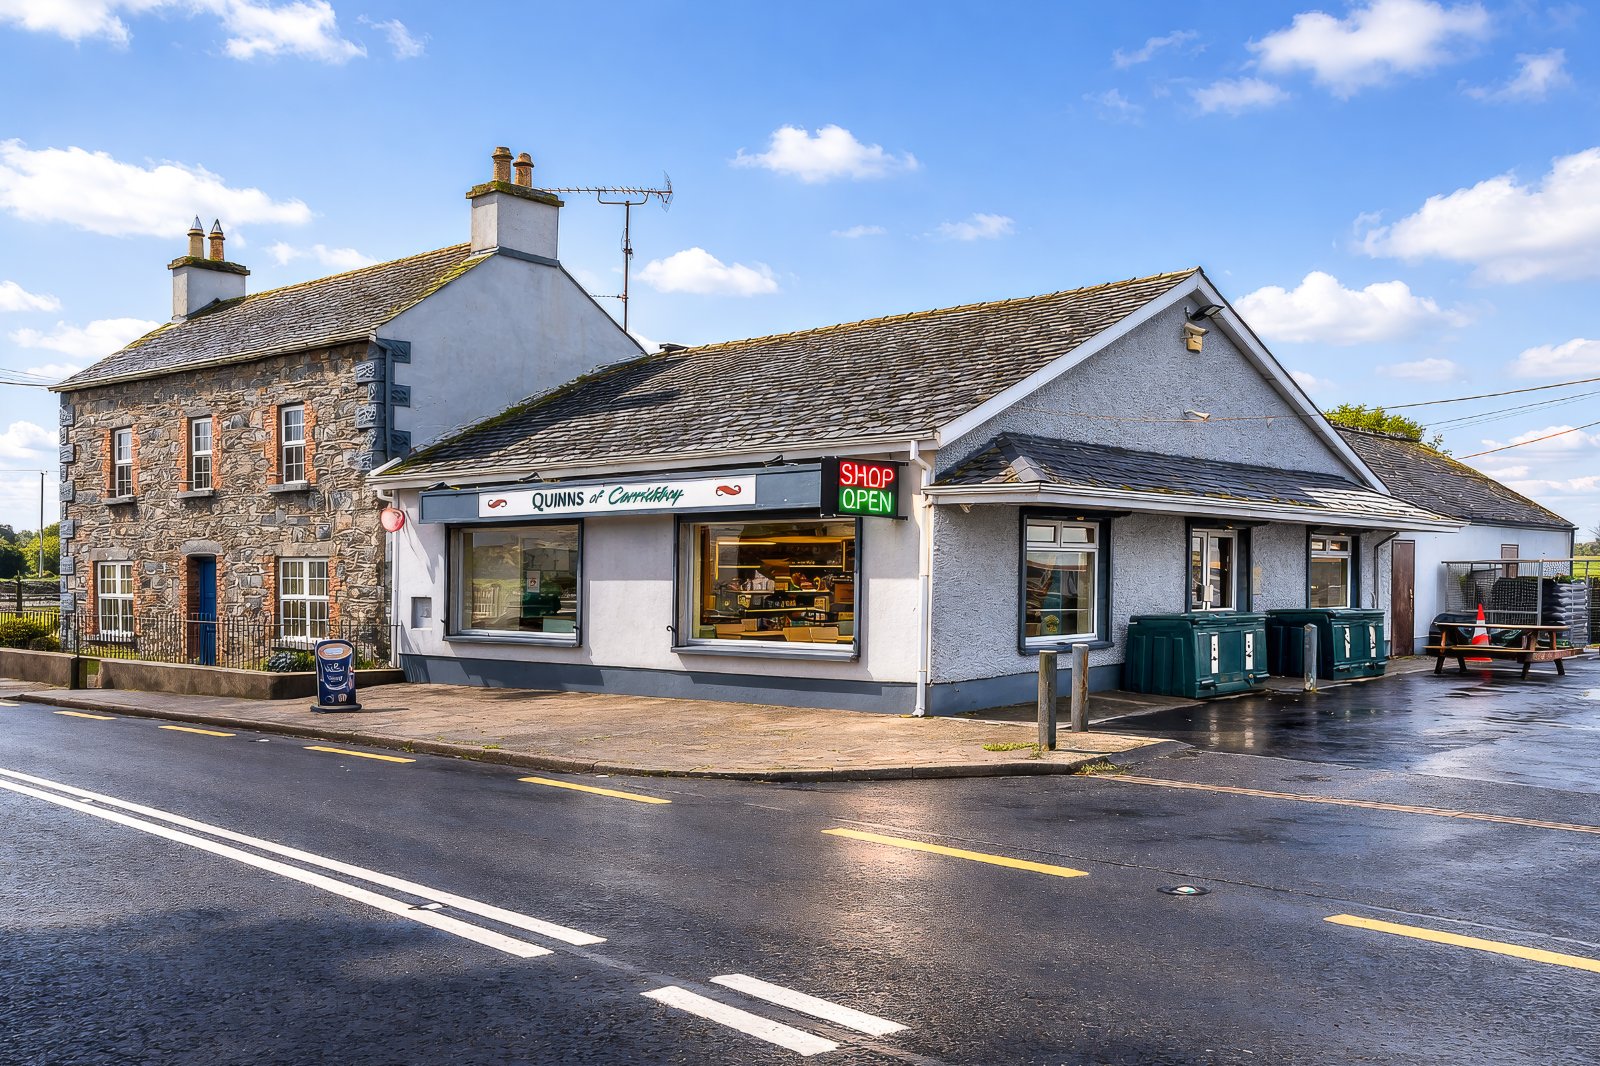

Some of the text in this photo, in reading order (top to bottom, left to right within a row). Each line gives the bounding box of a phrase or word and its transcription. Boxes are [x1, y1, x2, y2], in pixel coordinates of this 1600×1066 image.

[840, 463, 894, 489] SHOP
[532, 491, 584, 512] QUINNS
[589, 489, 605, 504] of
[842, 488, 892, 512] OPEN
